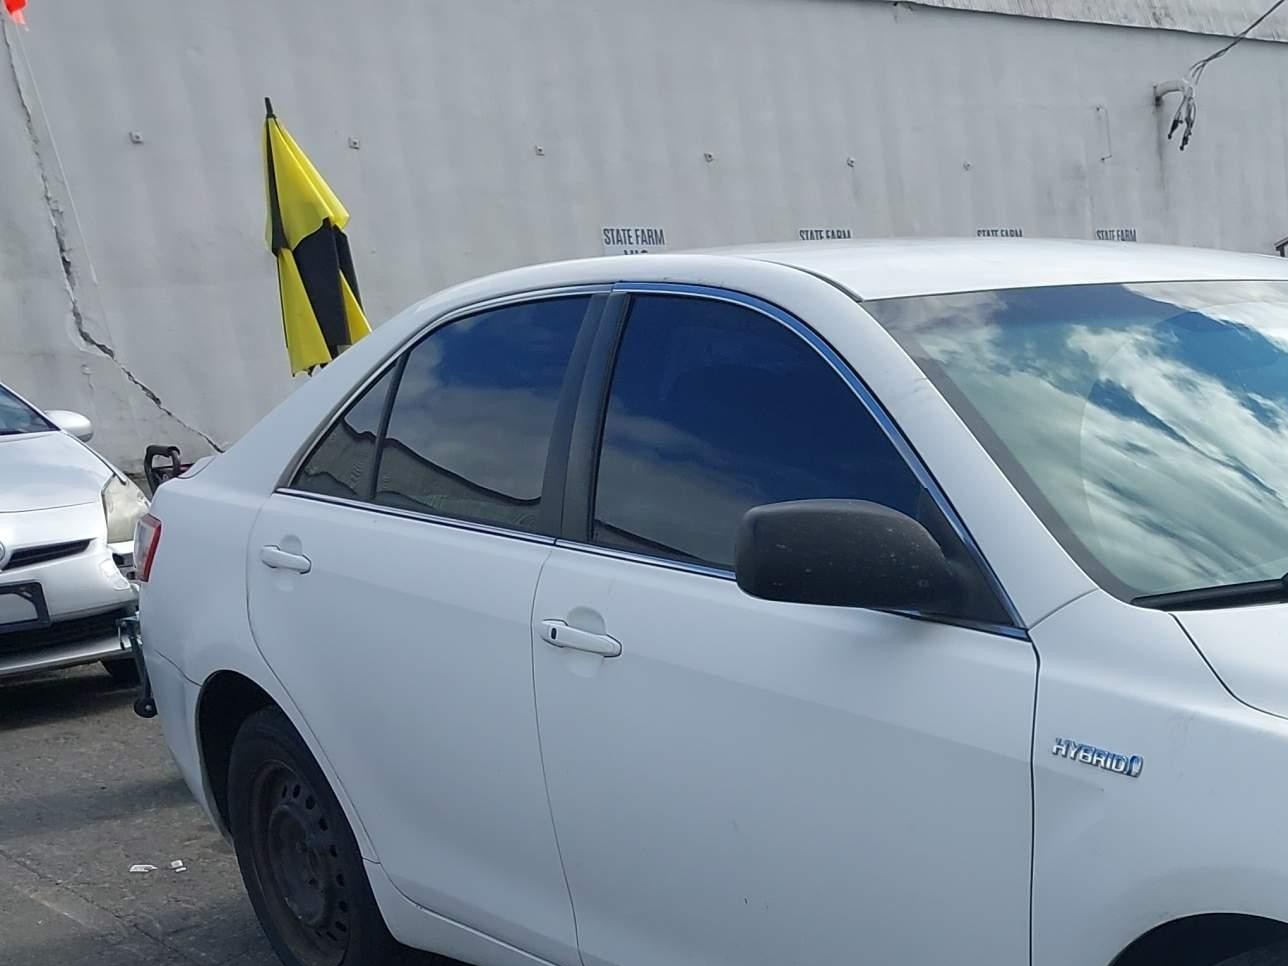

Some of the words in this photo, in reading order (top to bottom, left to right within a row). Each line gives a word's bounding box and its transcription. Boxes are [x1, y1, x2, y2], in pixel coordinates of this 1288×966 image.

[603, 228, 633, 245] STATE
[635, 228, 665, 245] FARM
[1051, 737, 1129, 776] HYBRID
